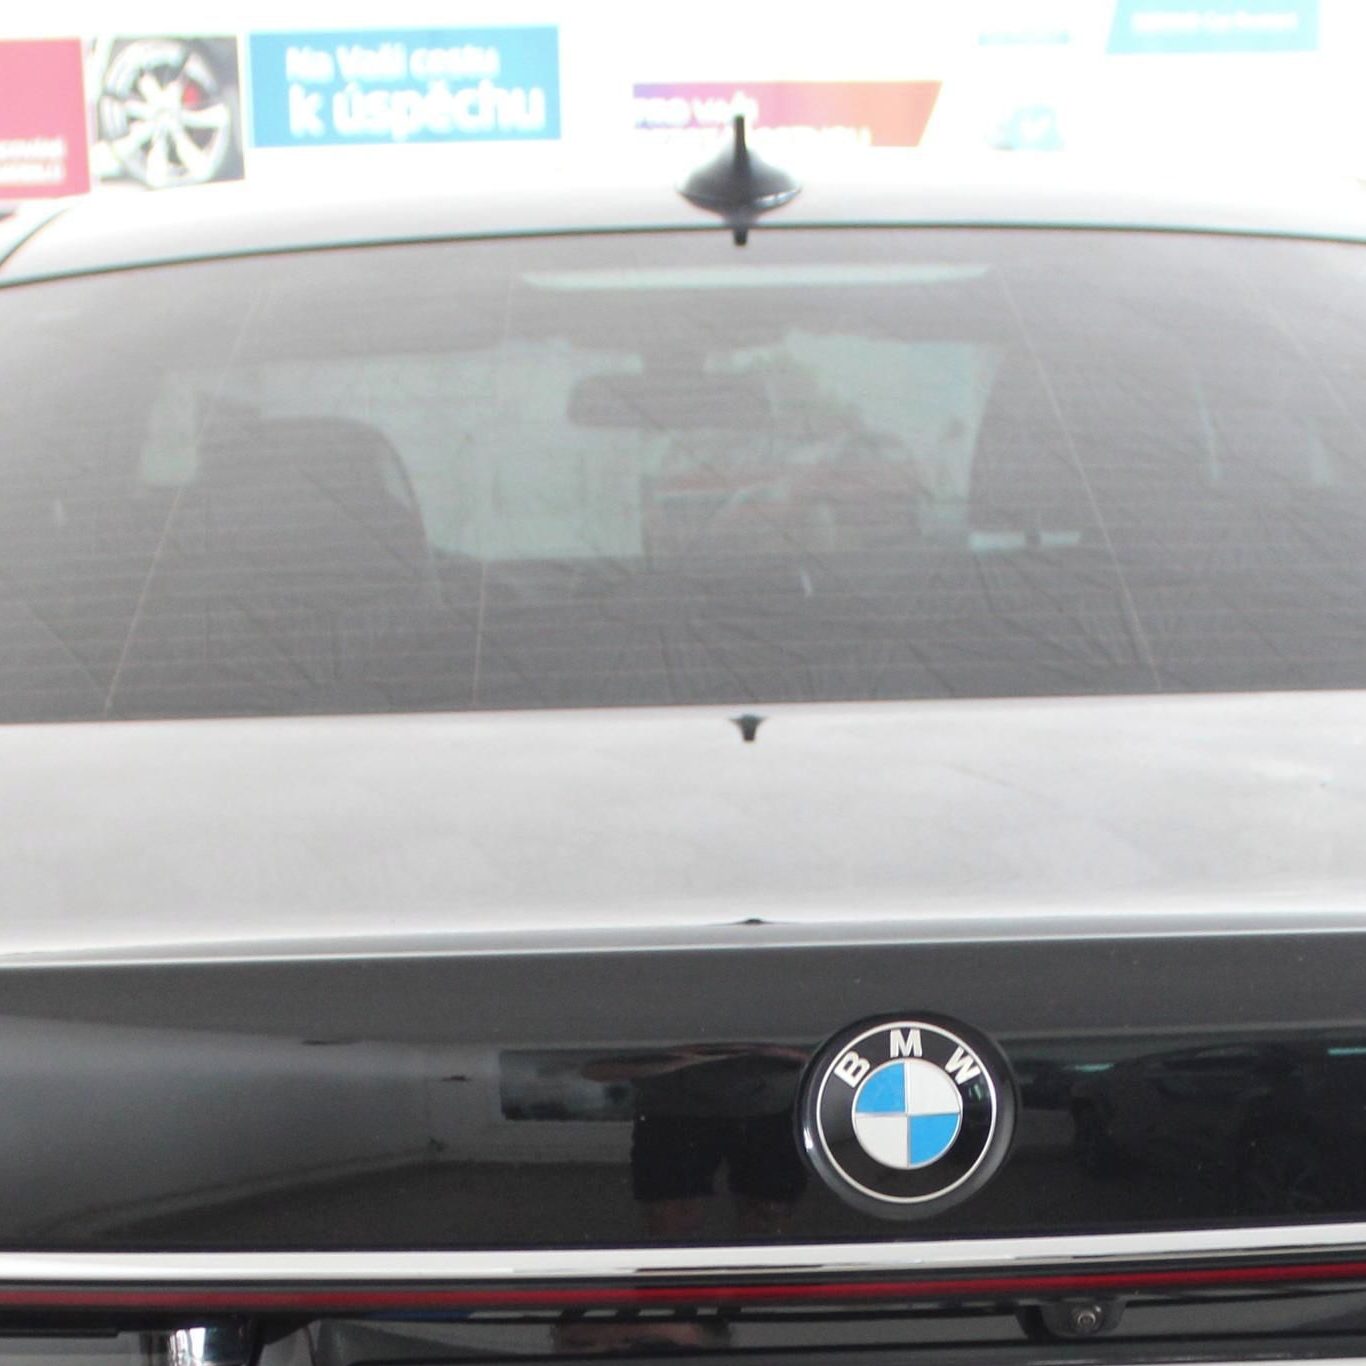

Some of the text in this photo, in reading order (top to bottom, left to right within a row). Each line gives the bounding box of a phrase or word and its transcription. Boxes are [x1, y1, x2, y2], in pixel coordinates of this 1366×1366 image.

[288, 78, 546, 142] k úspěchu
[833, 1028, 982, 1089] BMW
